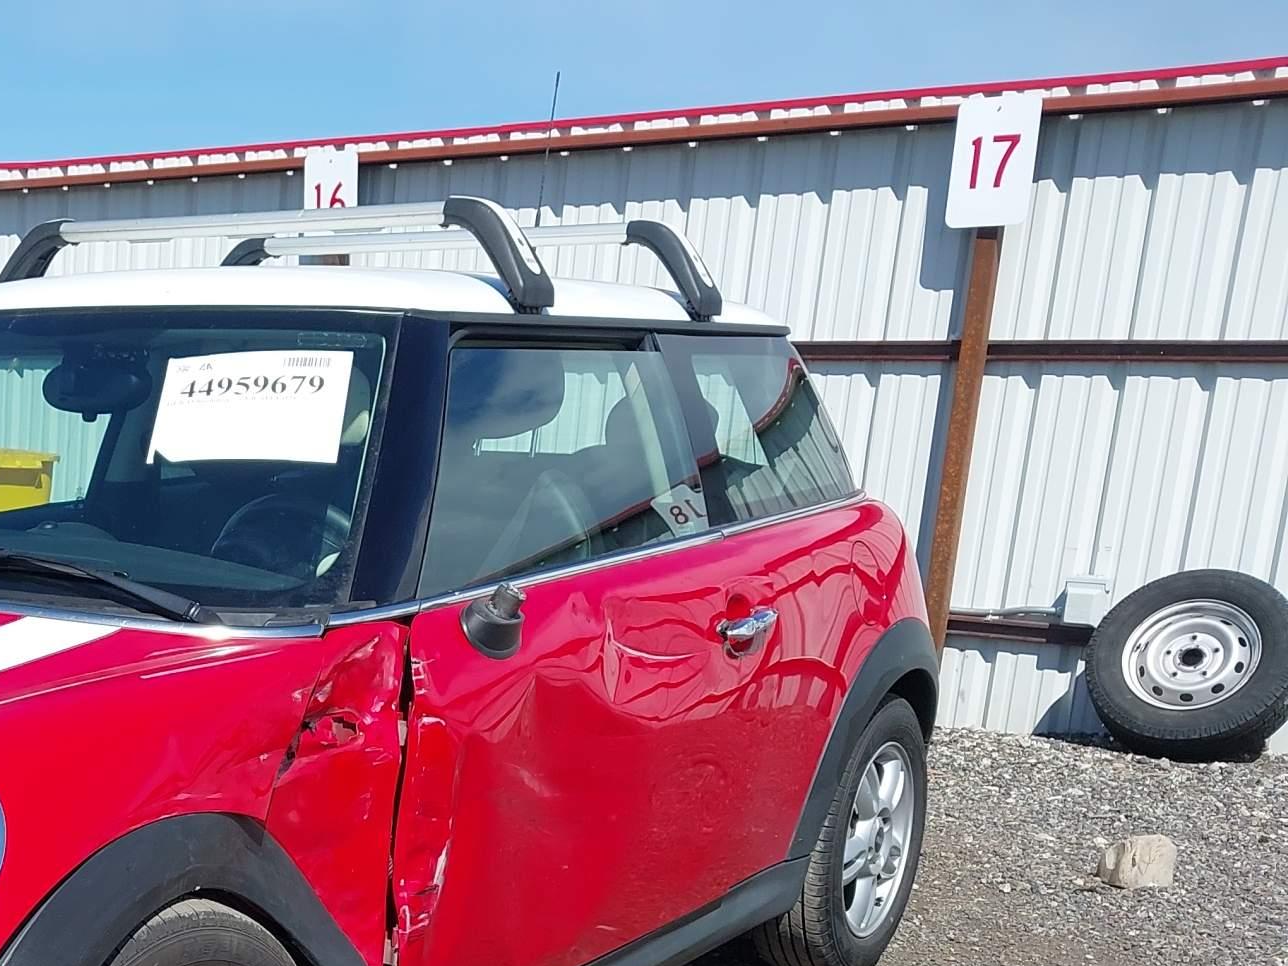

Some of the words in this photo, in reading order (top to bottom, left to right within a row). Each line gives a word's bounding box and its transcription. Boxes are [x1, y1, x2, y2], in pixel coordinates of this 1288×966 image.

[969, 133, 1022, 190] 17
[314, 181, 346, 209] 16
[180, 375, 325, 398] 44959679
